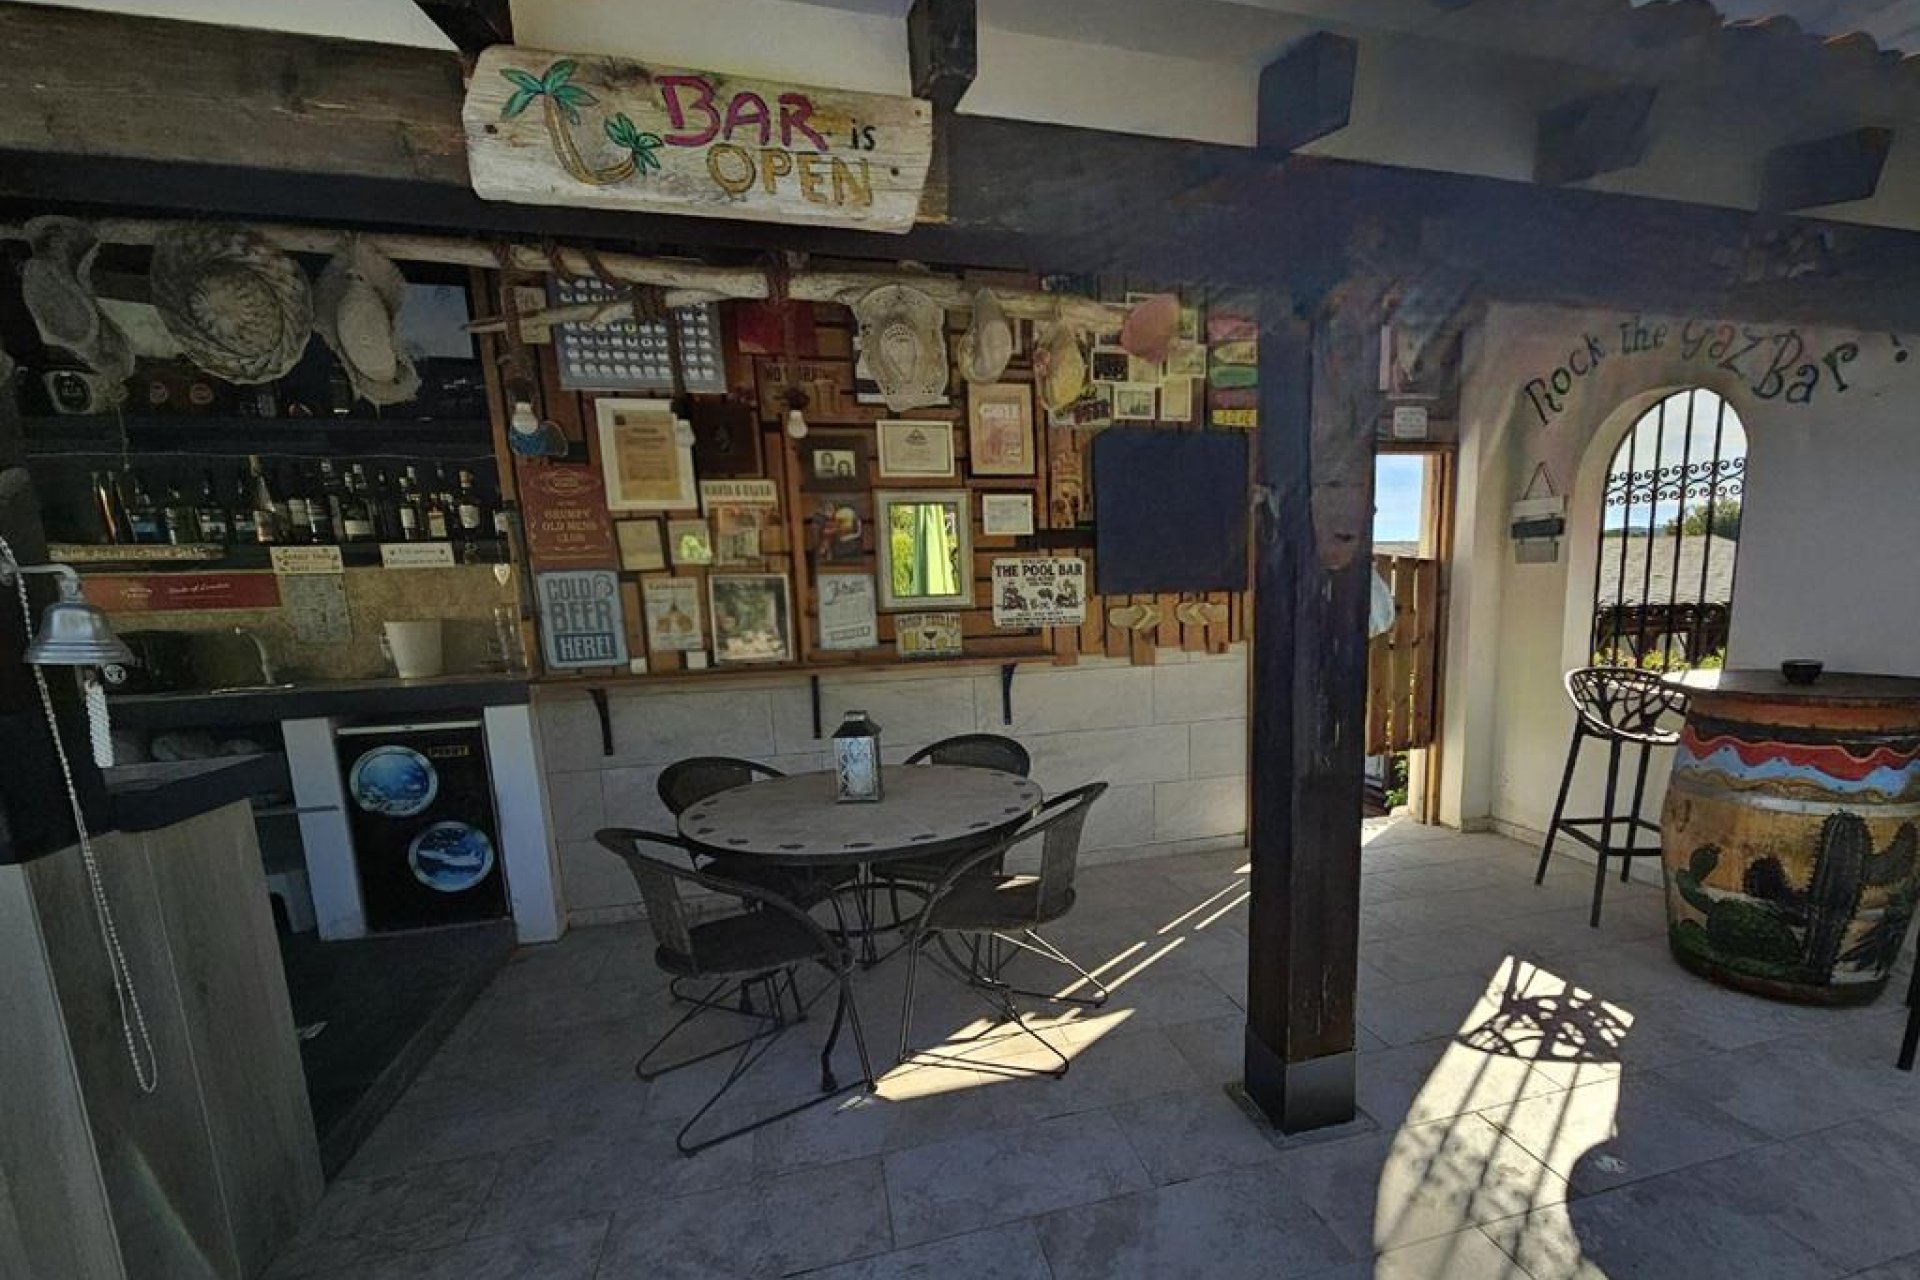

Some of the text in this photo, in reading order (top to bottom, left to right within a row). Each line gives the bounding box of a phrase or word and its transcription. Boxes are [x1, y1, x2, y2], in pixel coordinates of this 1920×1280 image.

[655, 75, 876, 152] BAR is
[706, 143, 873, 206] OPEN
[1525, 331, 1605, 426] Rock
[1619, 316, 1668, 354] the
[1752, 328, 1859, 403] Bar
[996, 563, 1083, 577] THE POOL BAR
[546, 578, 591, 601] COLD
[550, 601, 613, 632] BEER
[559, 634, 613, 660] HERE!
